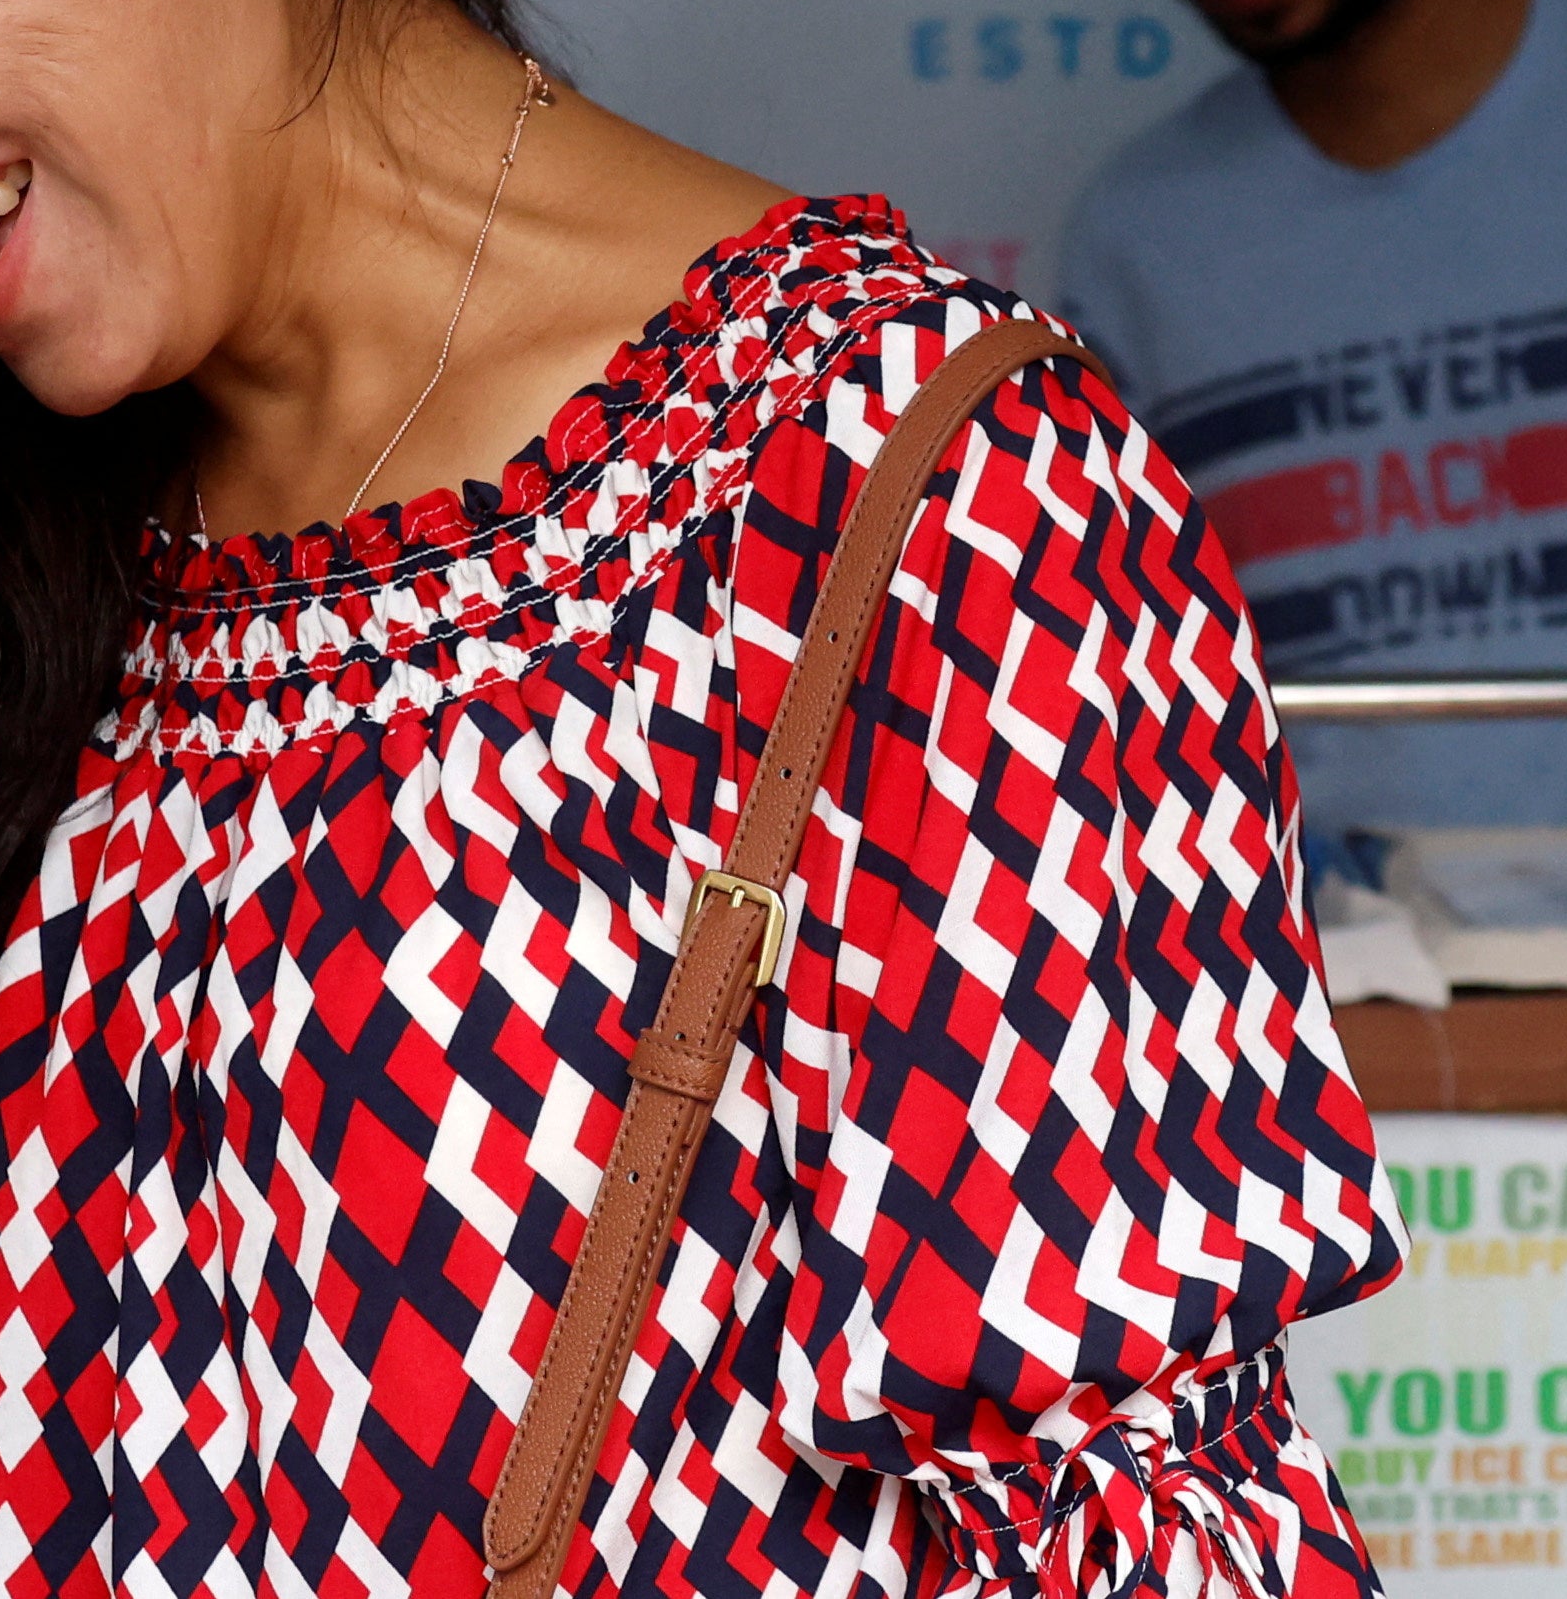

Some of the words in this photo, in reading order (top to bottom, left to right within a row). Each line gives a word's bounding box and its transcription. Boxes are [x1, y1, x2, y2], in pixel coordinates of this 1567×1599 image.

[908, 18, 1174, 81] ESTD
[1292, 325, 1519, 440] NEVER
[1322, 440, 1509, 537] BACK
[1336, 545, 1546, 645] DOWN
[1336, 1366, 1509, 1437] YOU
[1338, 1448, 1435, 1486] BUY
[1452, 1445, 1524, 1482] ICE
[1361, 1533, 1415, 1568] HE
[1434, 1531, 1564, 1567] SAME
